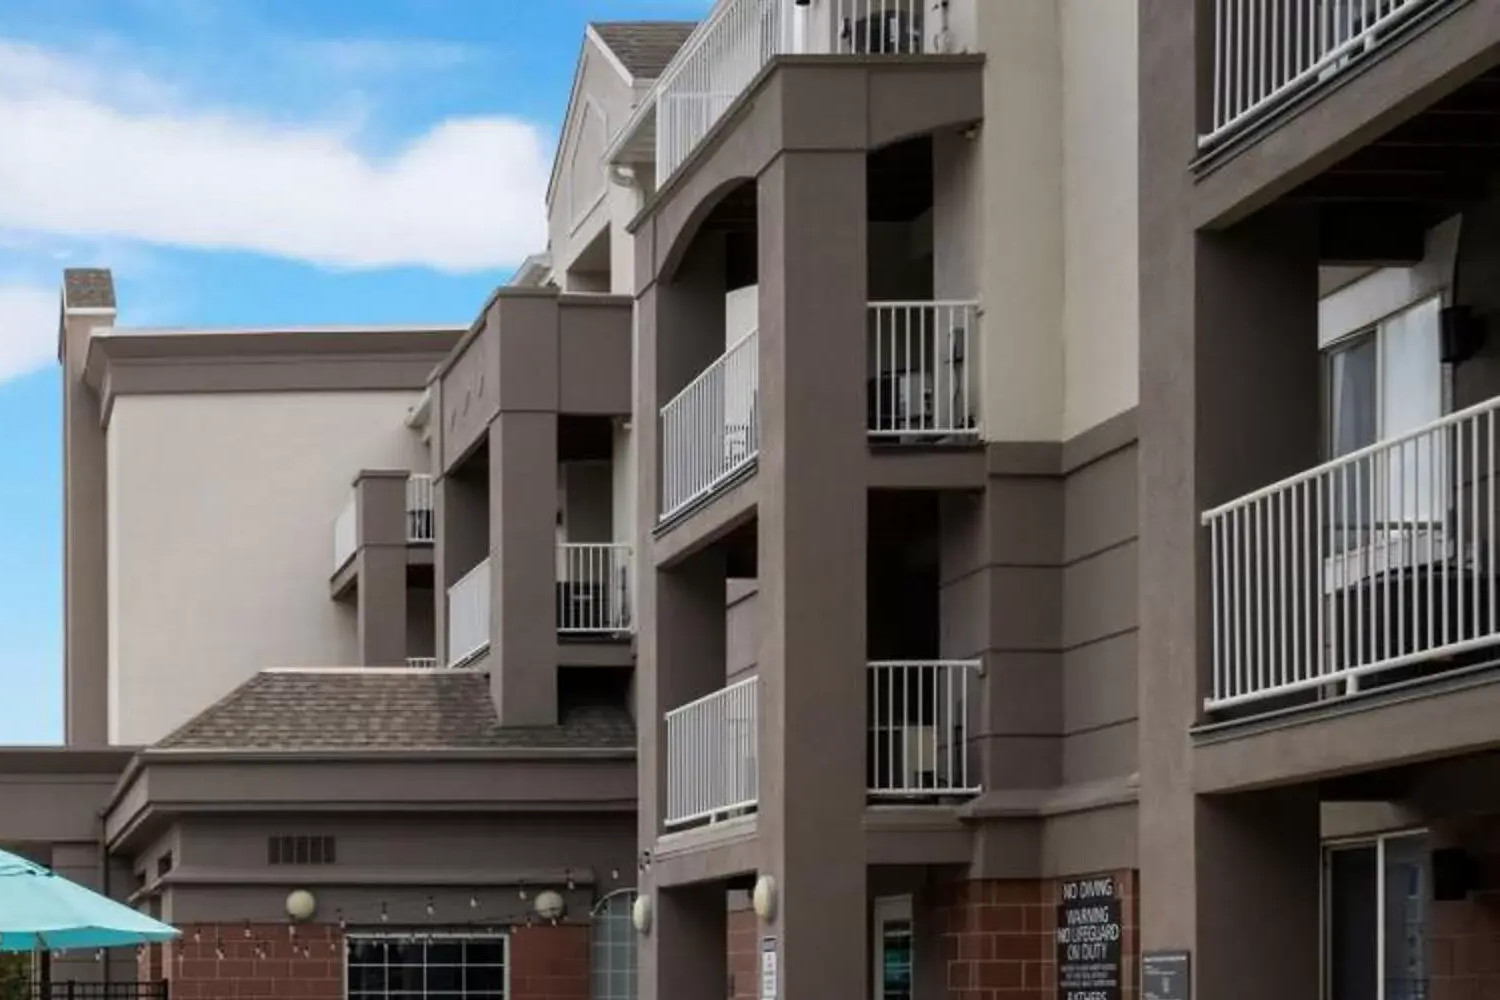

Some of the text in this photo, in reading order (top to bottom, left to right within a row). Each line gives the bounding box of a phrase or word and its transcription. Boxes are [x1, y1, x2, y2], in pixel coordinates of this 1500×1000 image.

[1063, 877, 1113, 899] NO DIVING
[1066, 905, 1110, 924] WARNING
[1057, 923, 1120, 943] NO LIFEGUARD
[1067, 942, 1107, 960] ON DUTY
